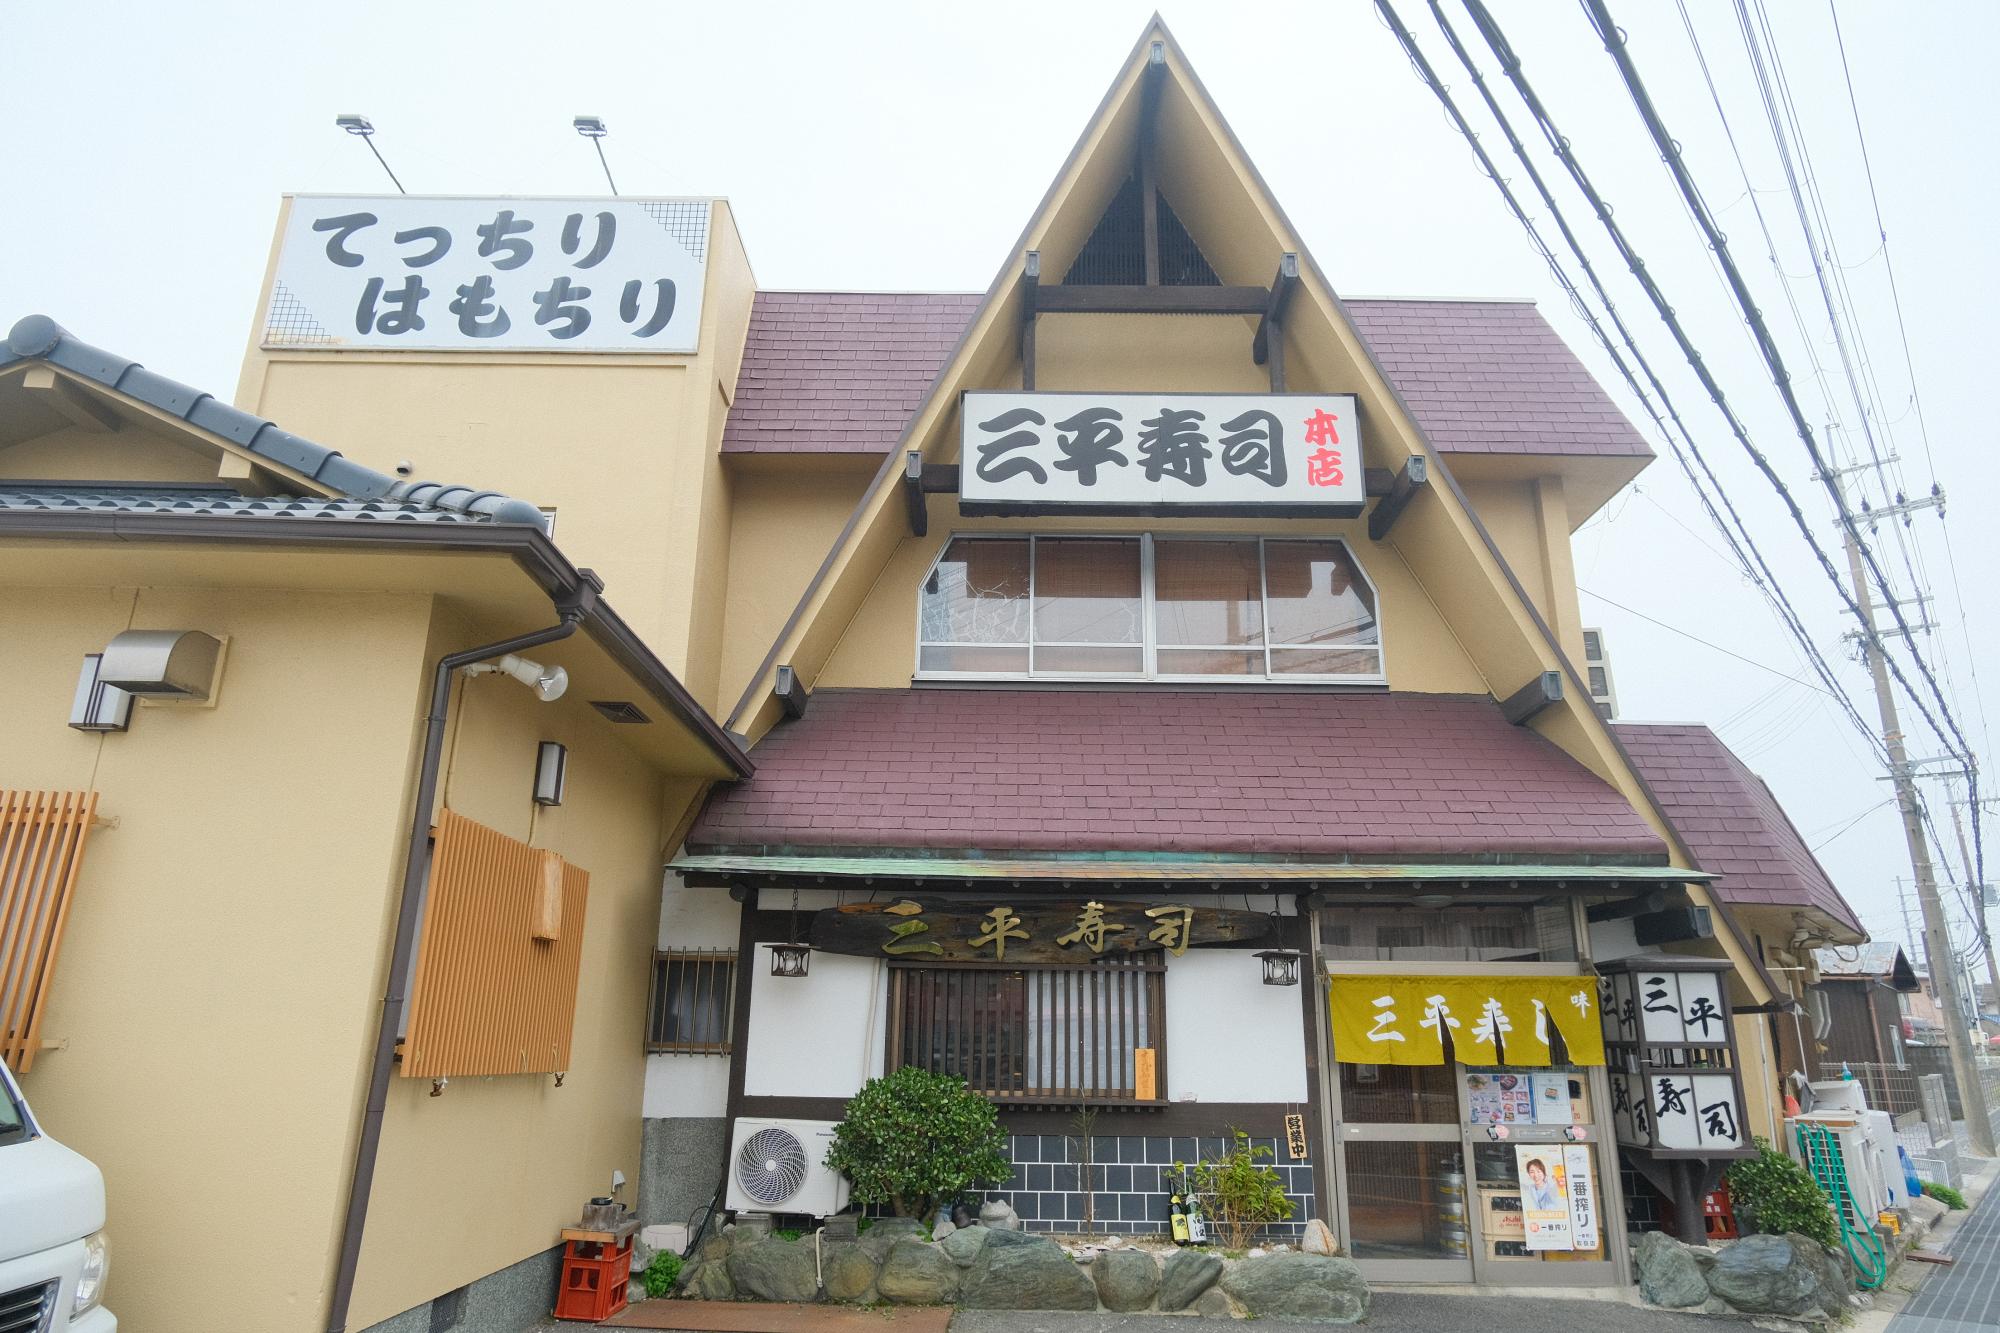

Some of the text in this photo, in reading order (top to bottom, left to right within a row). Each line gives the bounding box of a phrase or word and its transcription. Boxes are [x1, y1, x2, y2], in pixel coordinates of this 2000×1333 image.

[355, 274, 676, 340] はもちり
[976, 407, 1288, 487] 三平寿司
[1304, 408, 1344, 488] 本店
[882, 901, 1194, 957] 三平寿司
[1366, 994, 1550, 1049] 三平寿し
[1570, 990, 1591, 1019] 味
[1643, 976, 1722, 1038] 三平
[1287, 1115, 1305, 1158] 営業中
[1656, 1078, 1737, 1142] 寿司
[1572, 1174, 1590, 1228] 一番搾り
